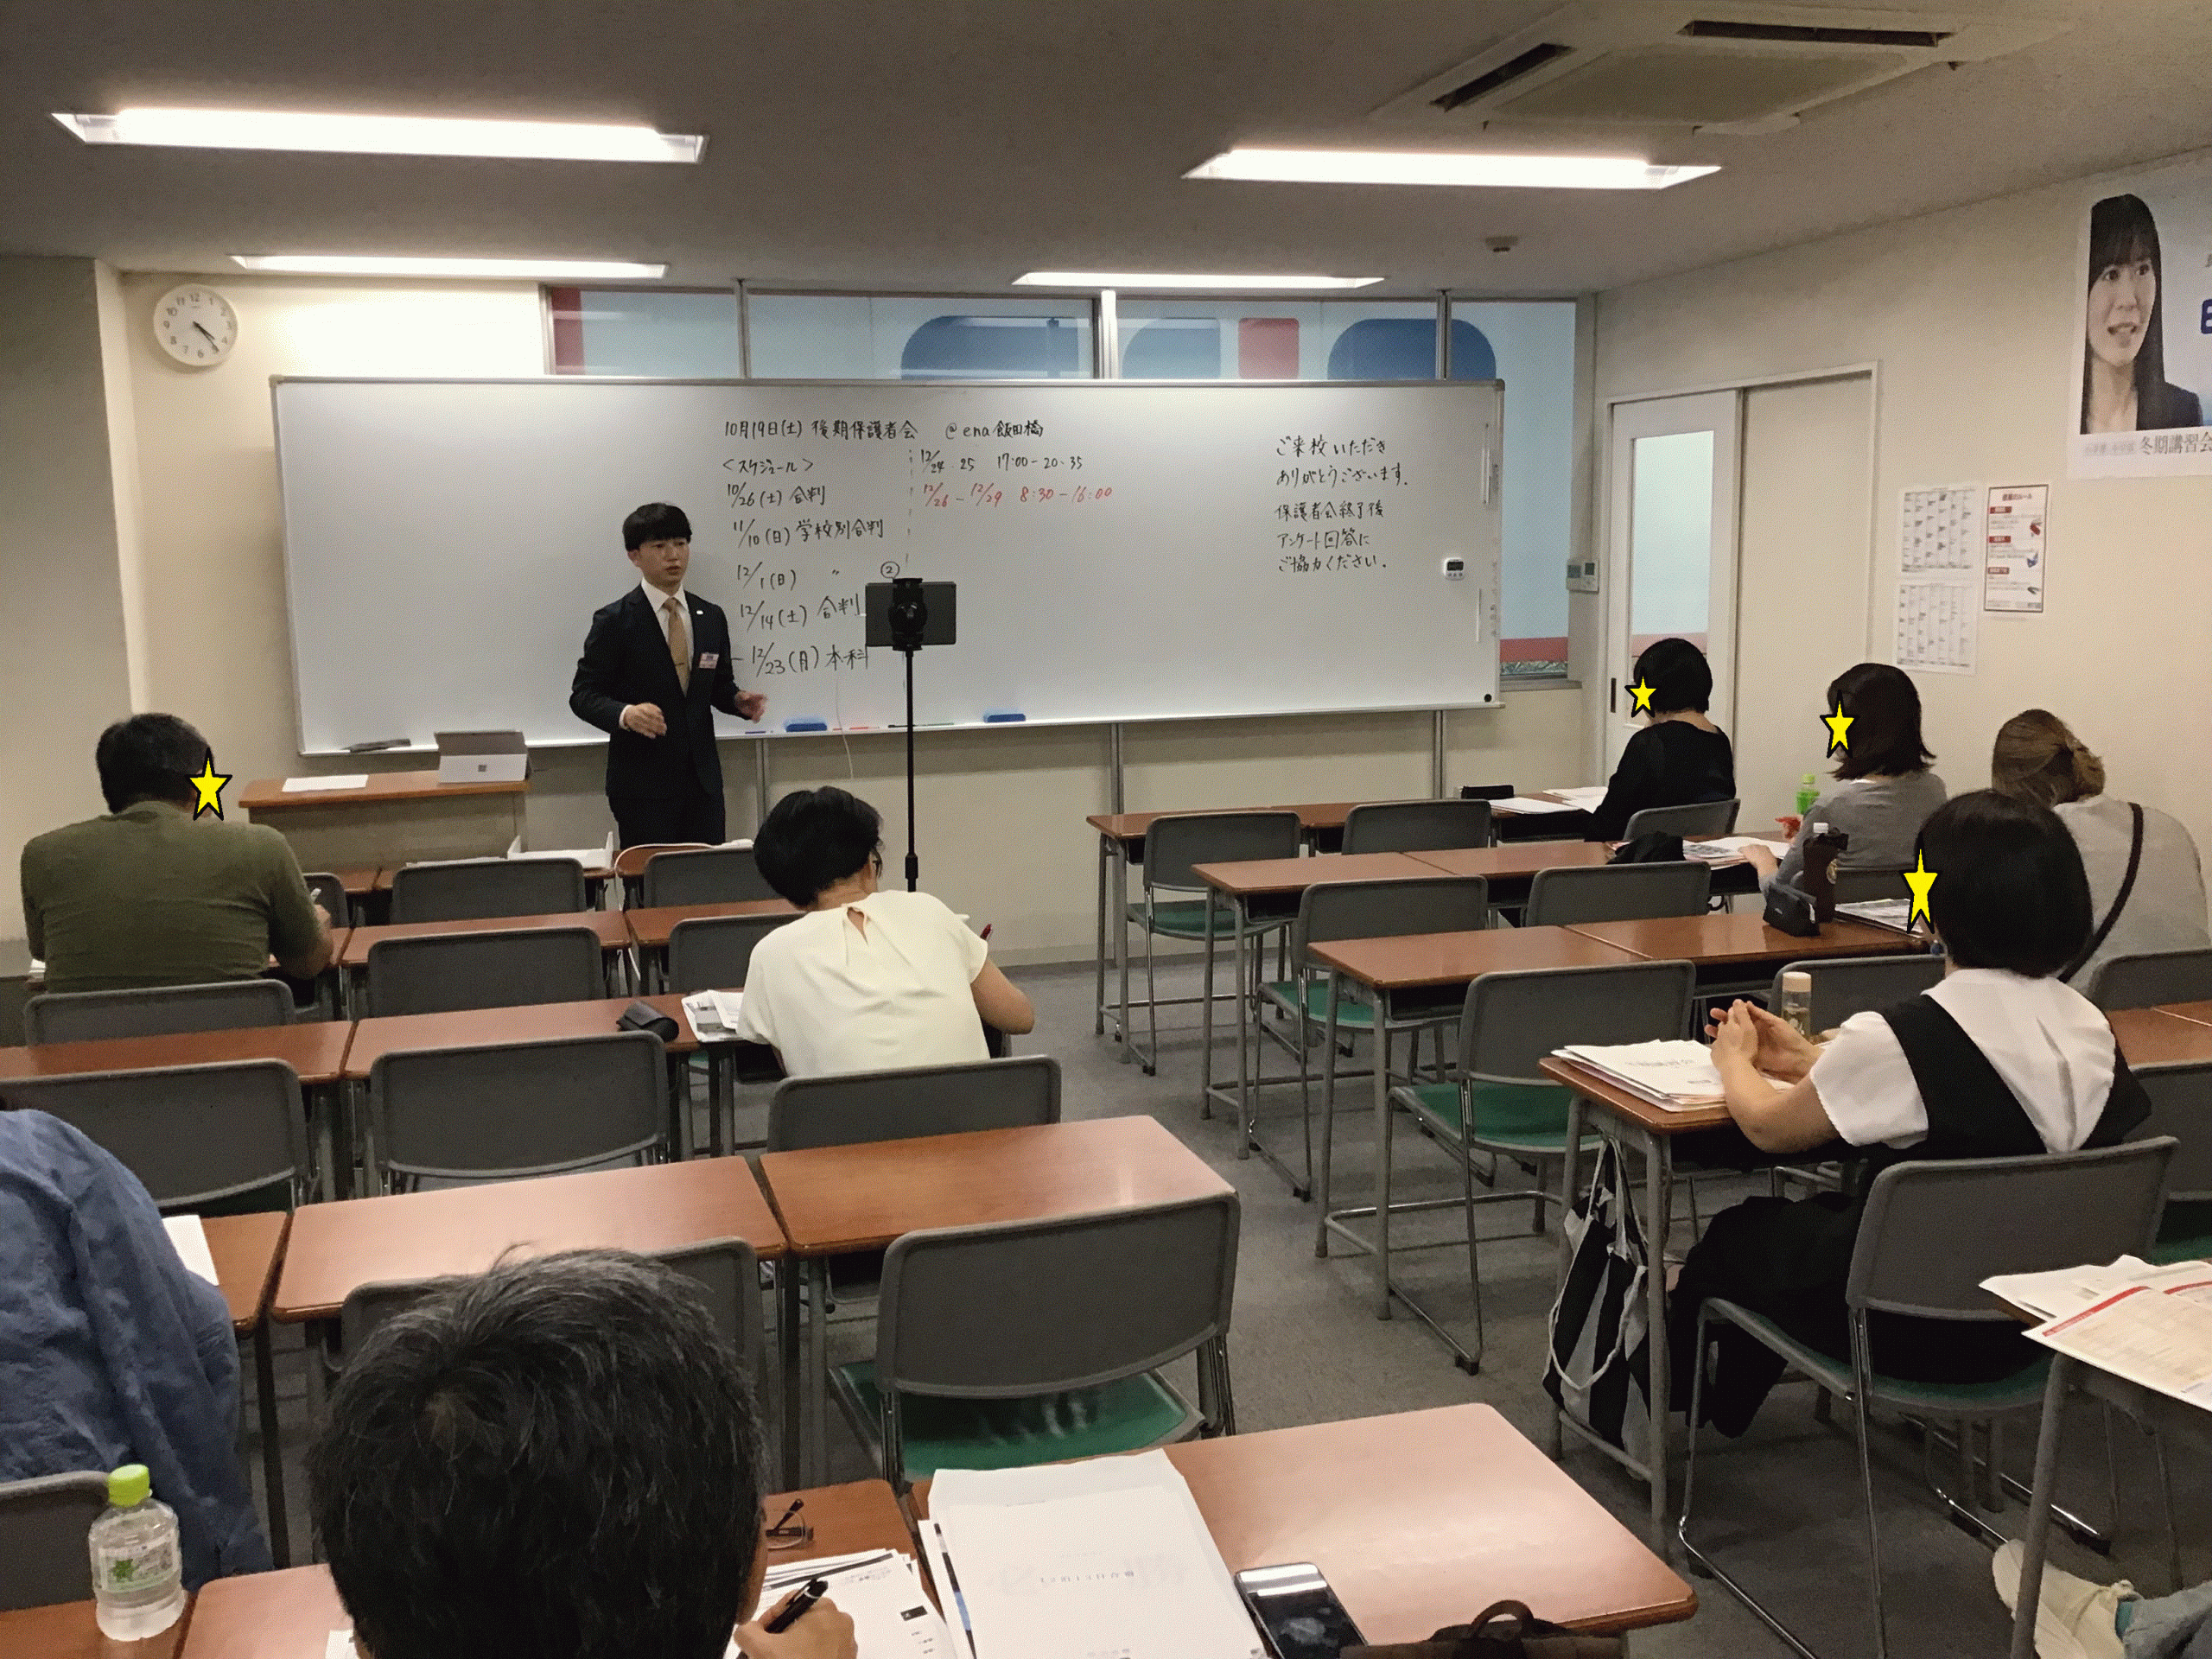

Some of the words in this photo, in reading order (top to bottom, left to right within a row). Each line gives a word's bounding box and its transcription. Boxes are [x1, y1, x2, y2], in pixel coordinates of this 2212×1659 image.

[725, 419, 802, 440] 10月19日(土)
[811, 419, 918, 440] 後期保護者会
[1276, 434, 1386, 458] ご来校いただき
[1274, 499, 1384, 522] 保護者会終了後
[1277, 527, 1370, 550] アンケート回答に
